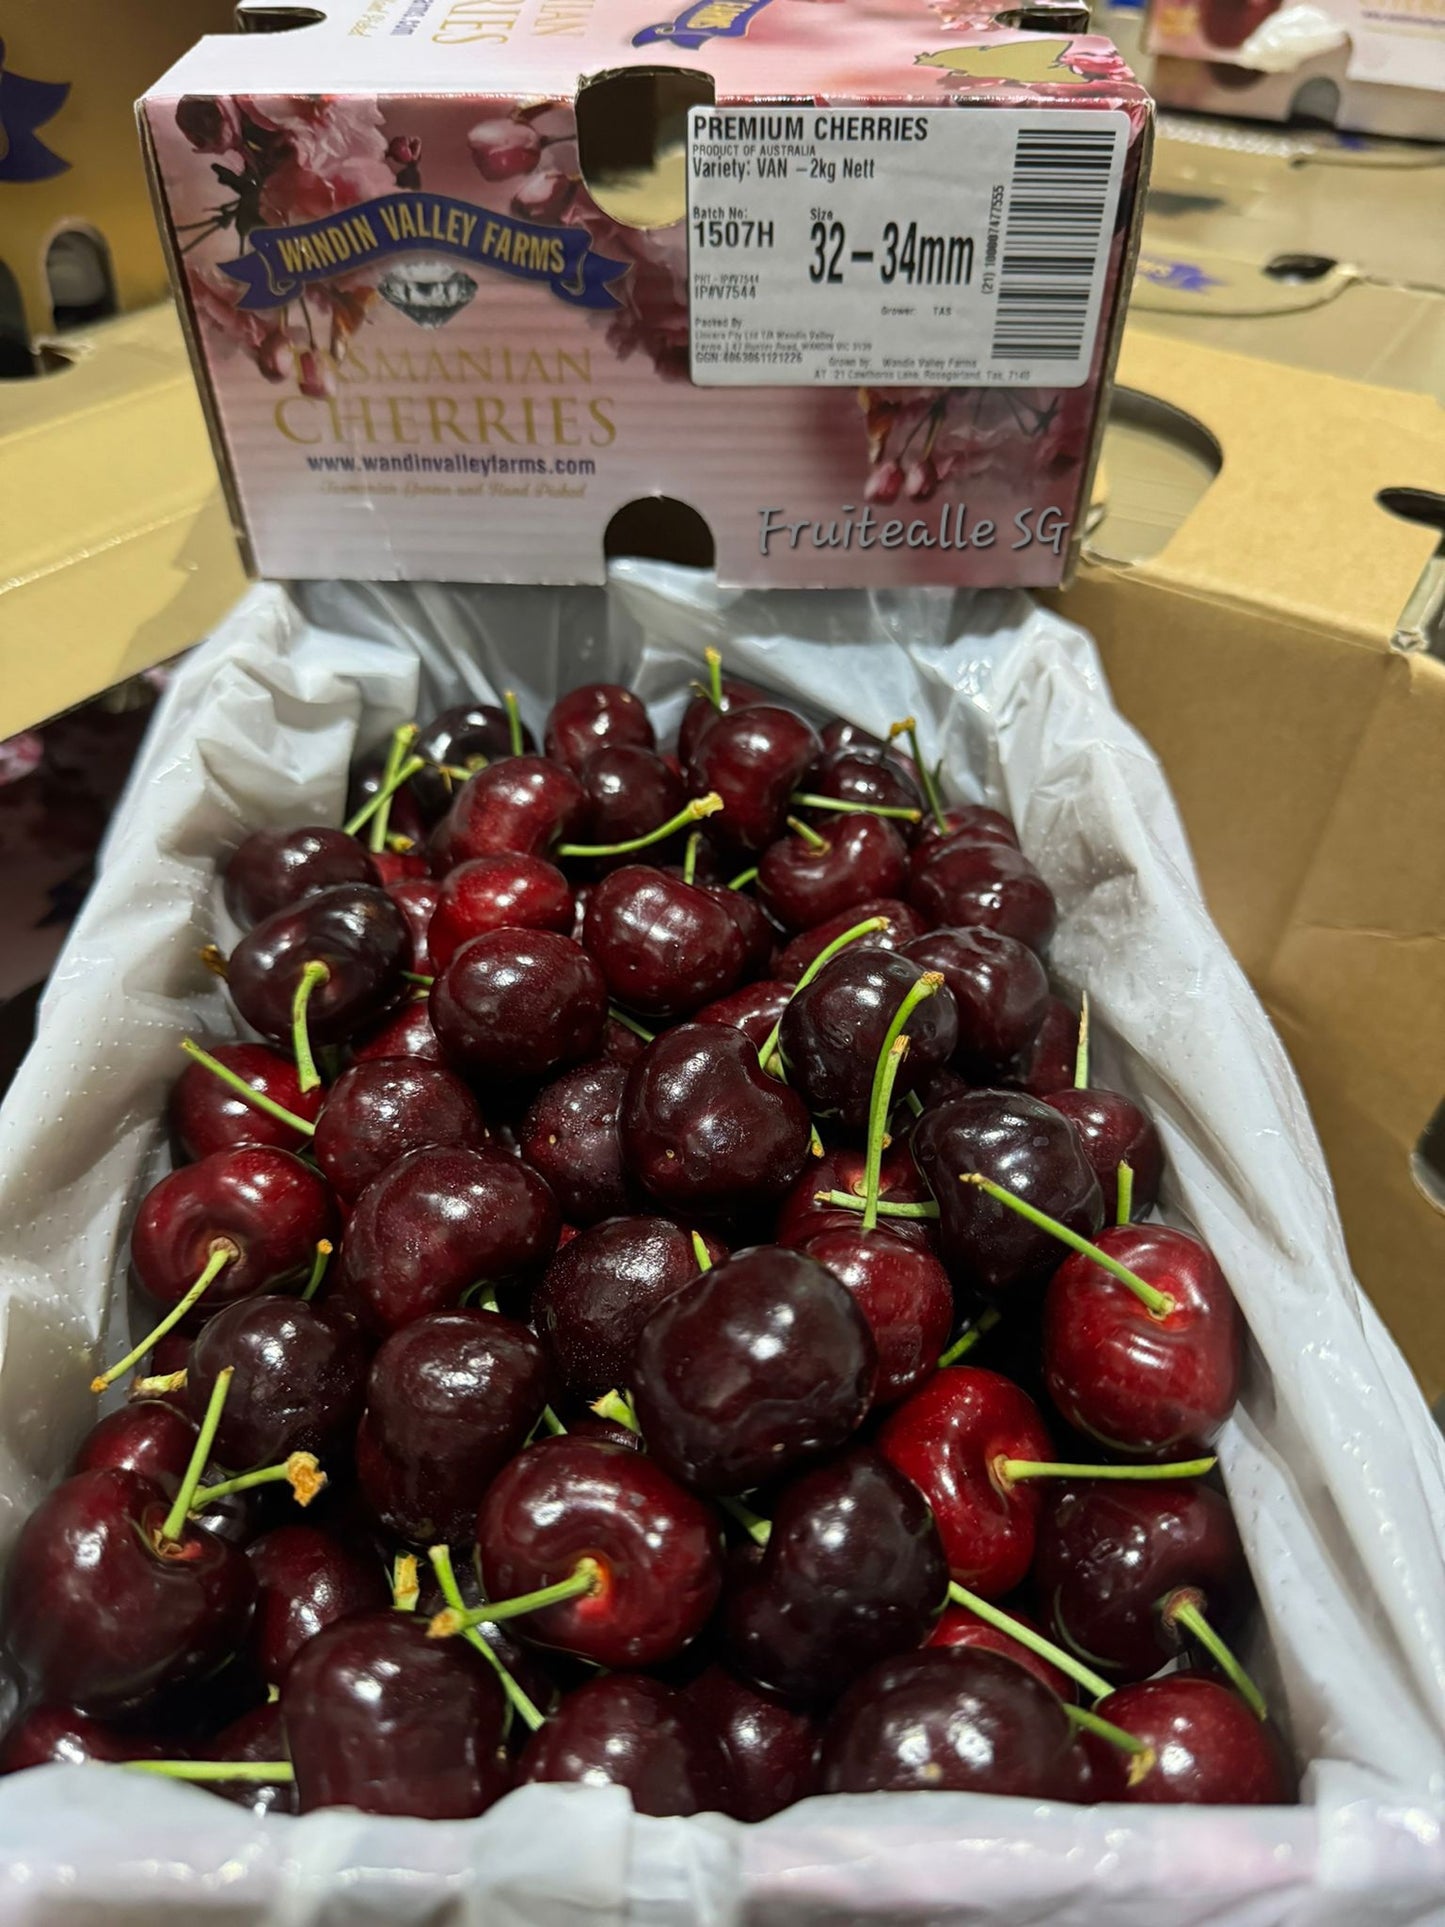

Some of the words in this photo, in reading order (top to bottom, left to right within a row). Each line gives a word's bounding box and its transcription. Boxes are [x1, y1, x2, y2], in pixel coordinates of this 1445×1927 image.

[693, 115, 804, 140] PREMIUM
[814, 116, 929, 141] CHERRIES
[693, 144, 739, 157] PRODUCT
[743, 144, 756, 157] OF
[760, 145, 817, 157] AUSTRALIA
[693, 158, 751, 182] Variety:
[757, 158, 788, 179] VAN
[843, 158, 875, 179] Nett
[693, 206, 725, 220] Batch
[810, 207, 834, 221] Size
[276, 214, 379, 274] WANDIN
[379, 201, 478, 248] VALLEY
[482, 218, 566, 275] FARMS
[693, 221, 775, 249] 1507H
[272, 395, 617, 447] CHERRIES
[307, 453, 596, 477] www.wandinvalleyfarms.com
